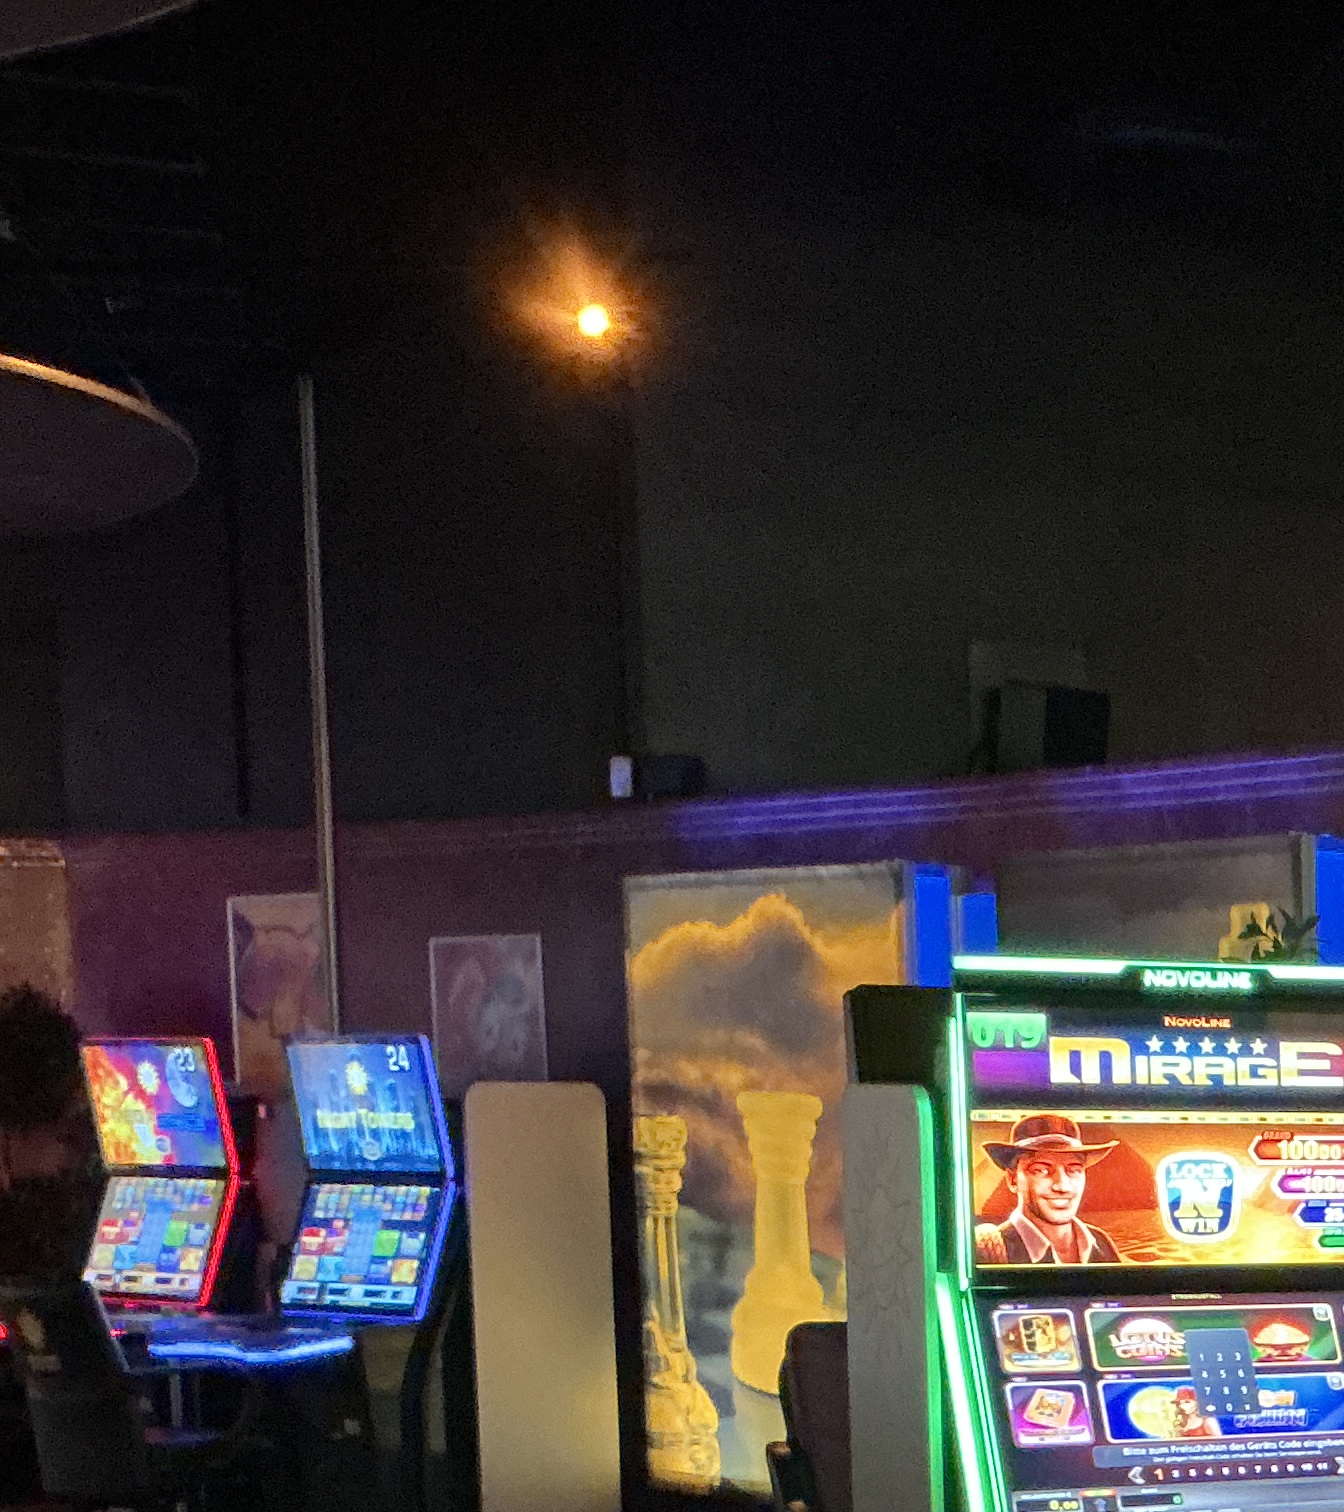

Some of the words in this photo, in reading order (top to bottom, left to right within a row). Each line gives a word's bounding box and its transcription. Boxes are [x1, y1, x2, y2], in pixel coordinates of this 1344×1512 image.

[1143, 969, 1253, 989] NOVOLINE
[173, 1046, 195, 1072] 23
[385, 1044, 411, 1072] 24
[1168, 1162, 1229, 1179] LOCK
[1178, 1218, 1220, 1233] WIN
[1108, 1331, 1186, 1346] LOTUS
[1115, 1343, 1184, 1359] COINS
[1229, 1442, 1246, 1451] des
[1278, 1440, 1302, 1449] Code
